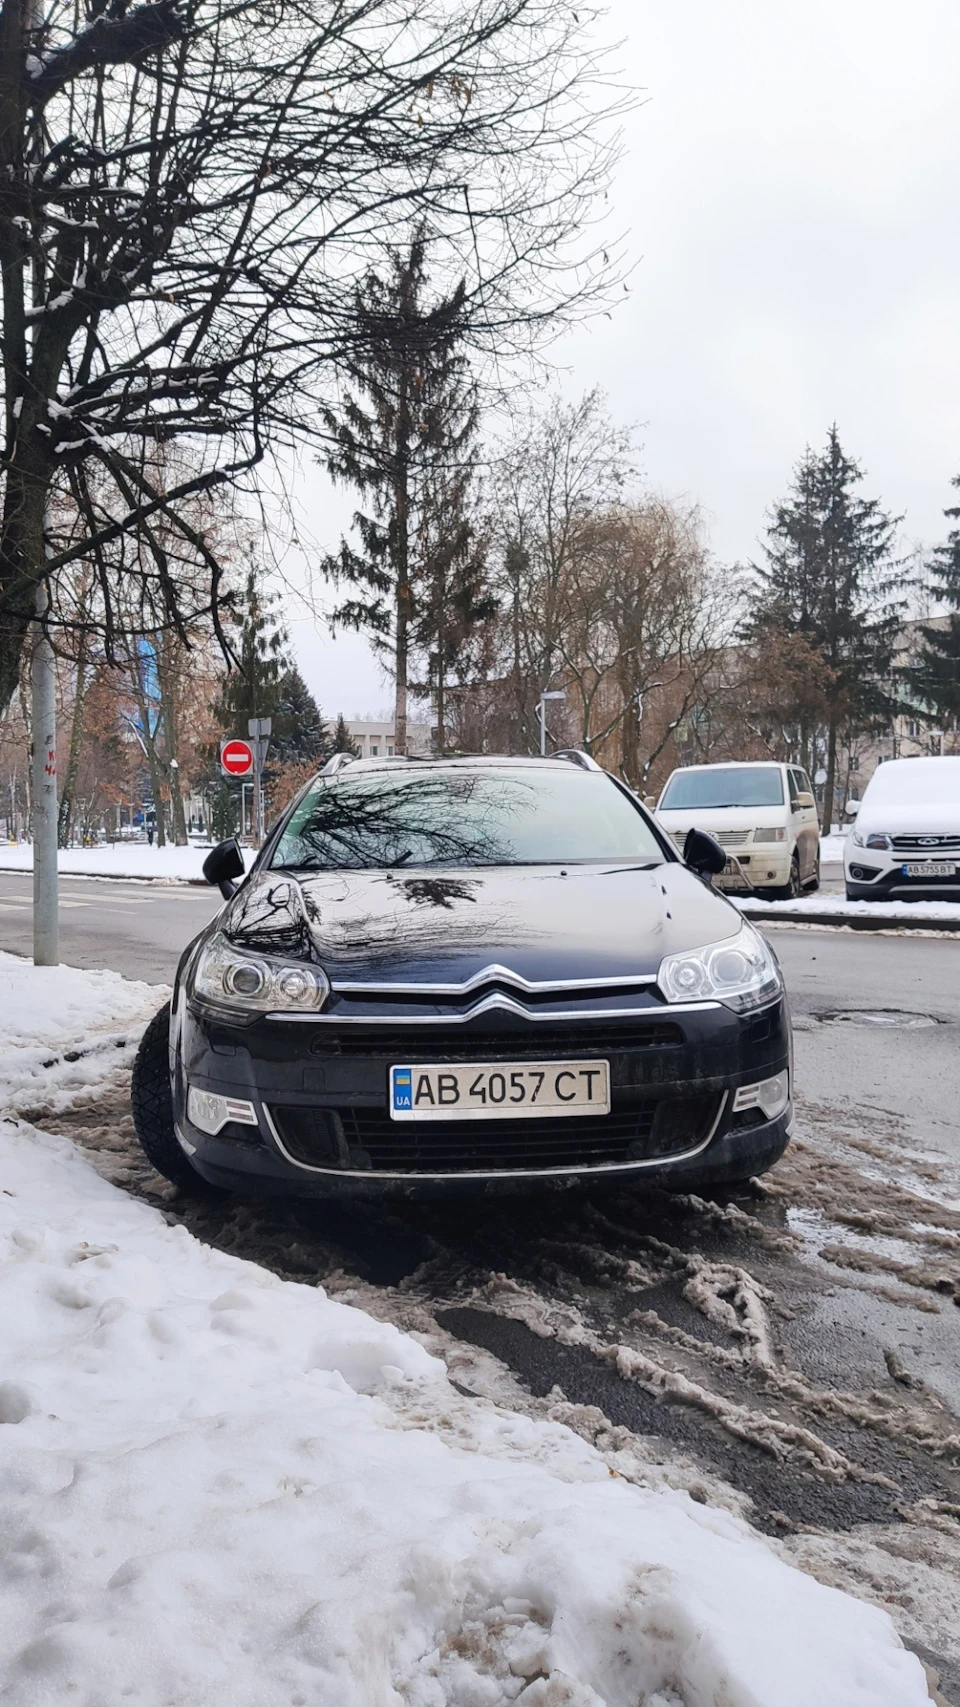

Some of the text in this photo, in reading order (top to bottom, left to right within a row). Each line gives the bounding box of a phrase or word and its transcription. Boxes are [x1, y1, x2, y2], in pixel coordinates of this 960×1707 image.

[908, 866, 919, 874] AB
[920, 865, 940, 874] 5755
[414, 1070, 601, 1105] AB 4057 CT
[396, 1096, 411, 1106] UA
